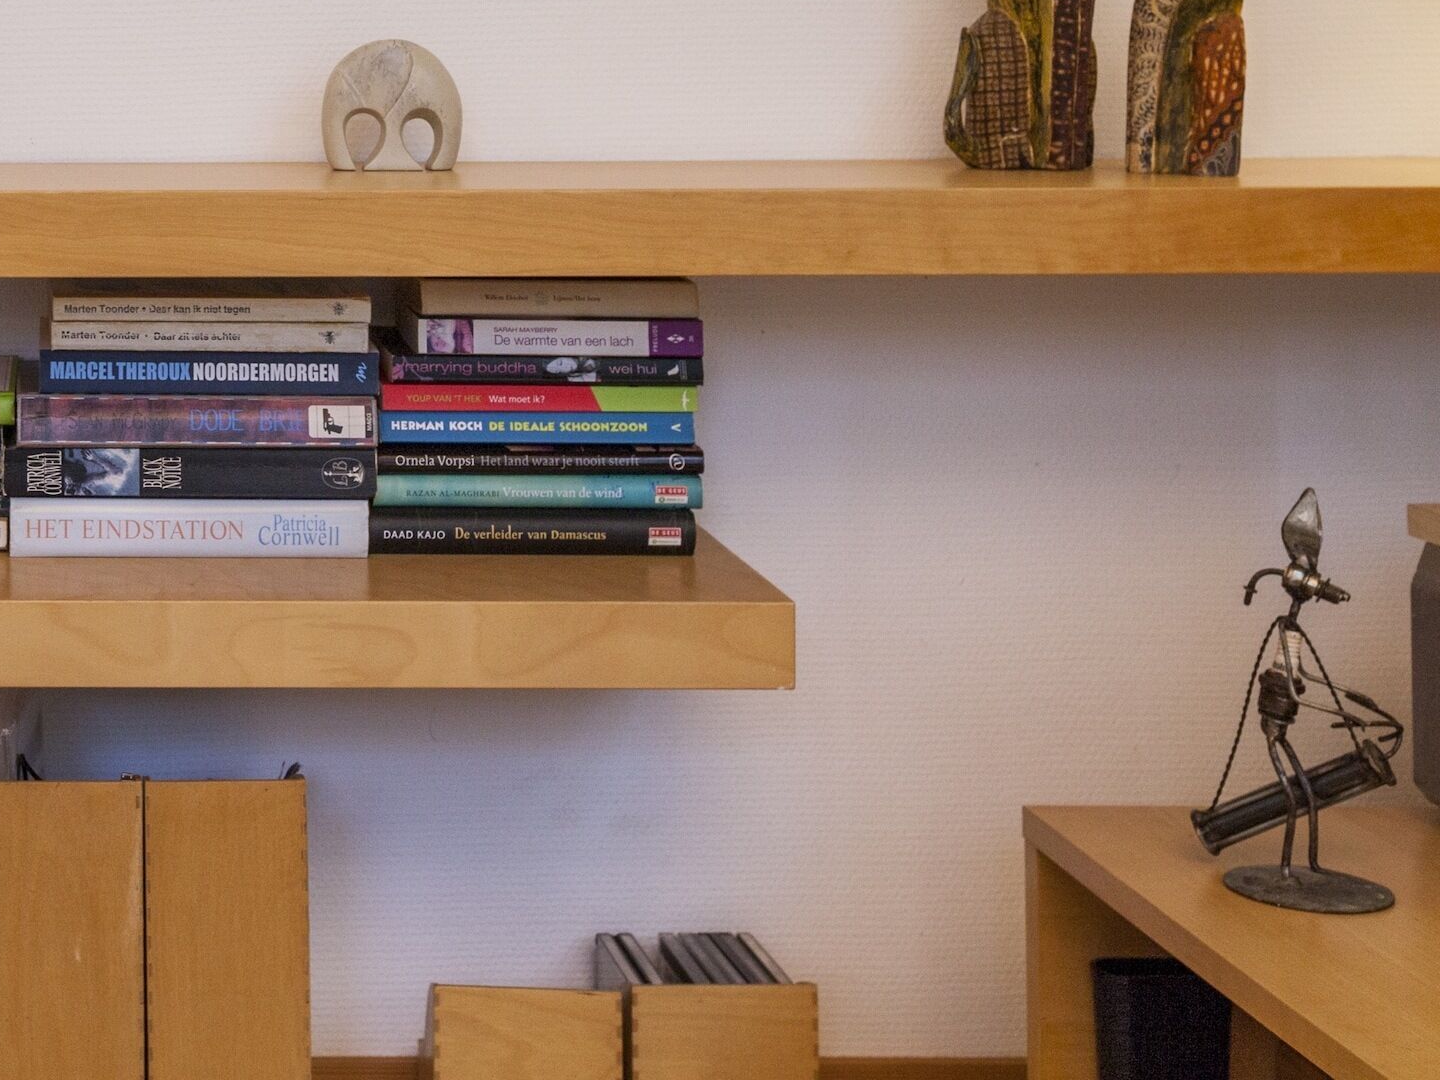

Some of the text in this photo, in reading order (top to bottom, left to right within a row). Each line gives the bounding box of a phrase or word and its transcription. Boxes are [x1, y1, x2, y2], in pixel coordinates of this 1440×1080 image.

[64, 304, 97, 314] Marten
[100, 304, 139, 314] Toonder
[173, 304, 191, 314] kan
[223, 304, 251, 316] tegen
[61, 330, 96, 340] Marten
[494, 334, 634, 347] De warmte van een lach
[50, 361, 340, 382] MARCEL THEROUX NOORDERMORGEN
[477, 360, 536, 374] buddha
[608, 364, 633, 374] wei
[636, 363, 658, 374] hui
[406, 394, 432, 402] YOUP
[434, 394, 452, 402] VAN
[464, 394, 482, 402] HEK
[489, 395, 506, 404] Wat
[508, 396, 531, 404] moet
[532, 396, 545, 404] ik?
[190, 409, 244, 432] DODE
[391, 420, 648, 432] HERMAN KOCH DE IDEALE SCHOONZOON
[395, 454, 640, 470] Ornela Vorpsi Het land waar je nooit sterft
[26, 452, 46, 493] PATRICIA
[44, 450, 62, 496] CORNWELL
[142, 458, 162, 489] BLACK
[162, 456, 182, 490] NOTICE
[439, 490, 500, 498] AL-MAGHRABI
[502, 486, 554, 498] Vrouwen
[556, 488, 576, 498] van
[578, 486, 592, 498] de
[594, 486, 624, 498] wind
[24, 518, 74, 539] HET
[82, 519, 244, 540] EINDSTATION
[274, 514, 326, 532] Patricia
[258, 526, 340, 546] Cornwell
[383, 524, 607, 540] DAAD KAJO De verleider van Damascus
